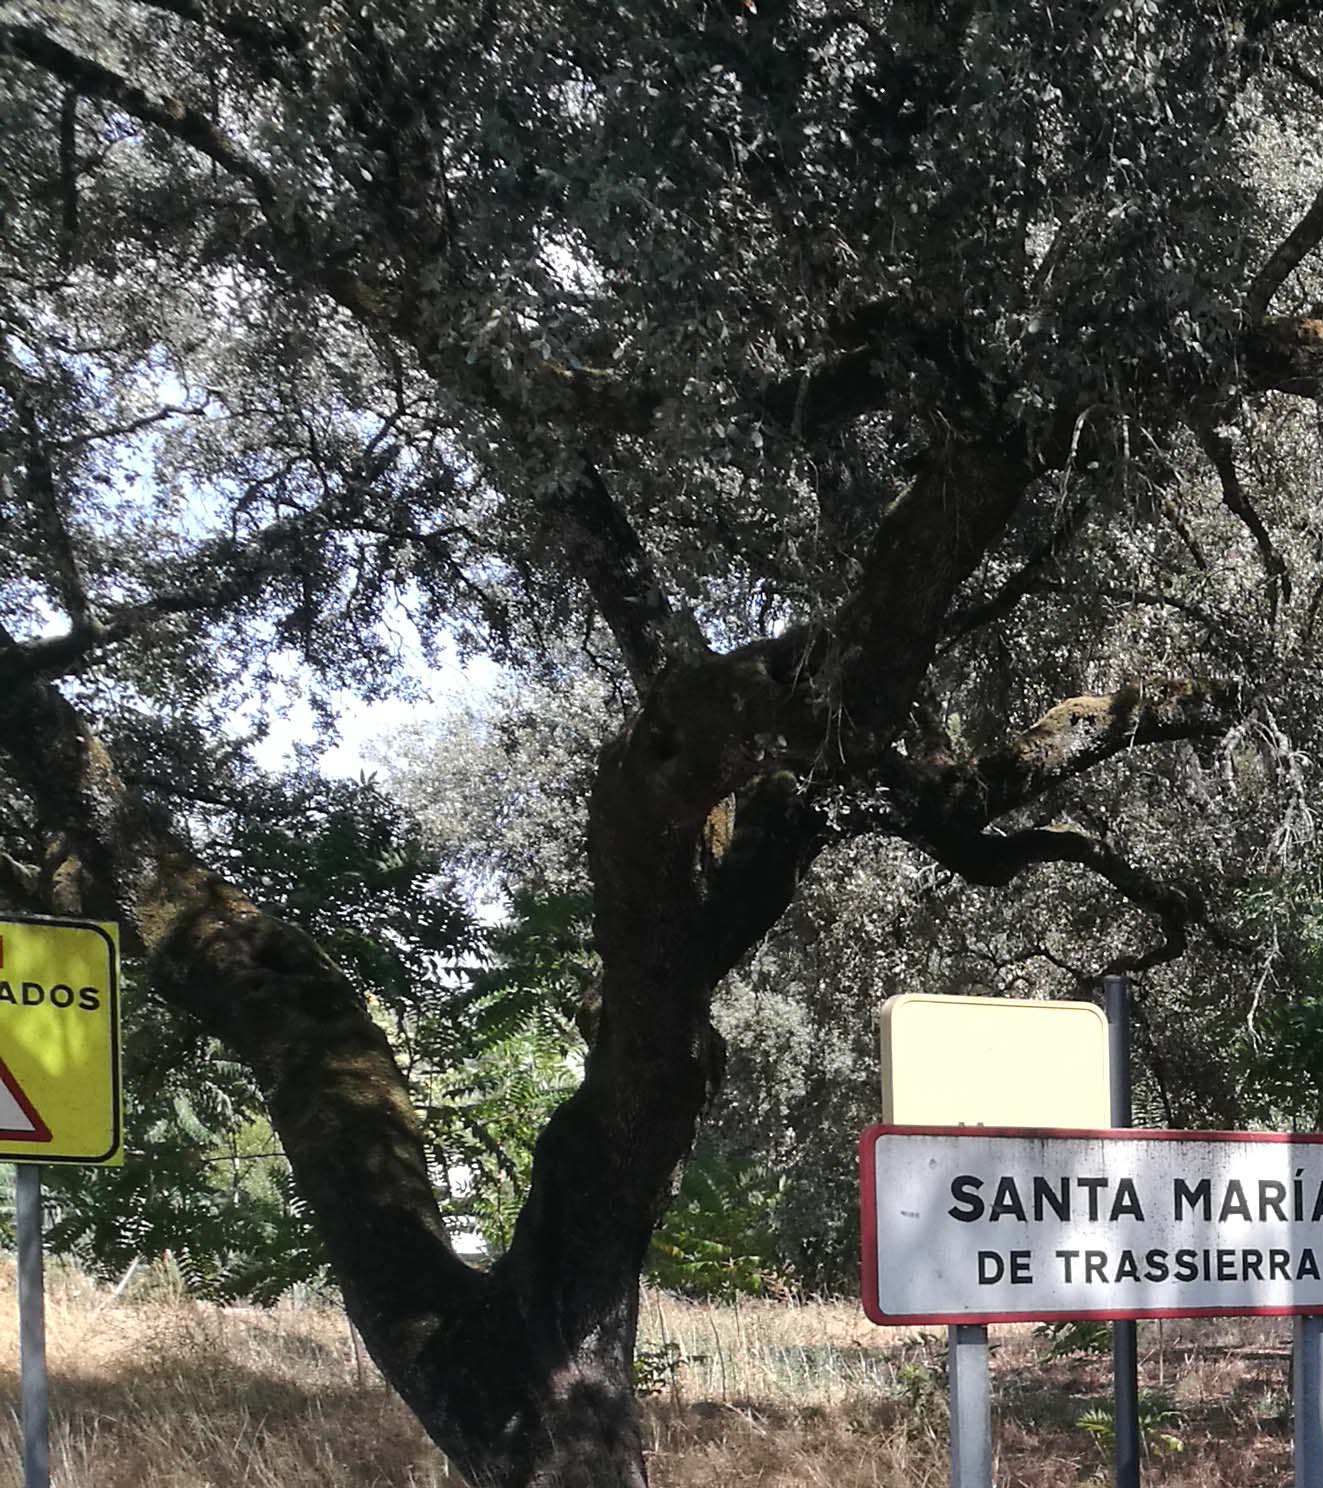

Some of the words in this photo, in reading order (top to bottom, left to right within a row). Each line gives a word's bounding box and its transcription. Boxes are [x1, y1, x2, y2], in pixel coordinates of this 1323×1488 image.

[948, 1174, 1145, 1222] SANTA
[977, 1249, 1033, 1285] DE
[1055, 1247, 1322, 1284] TRASSIERRA
